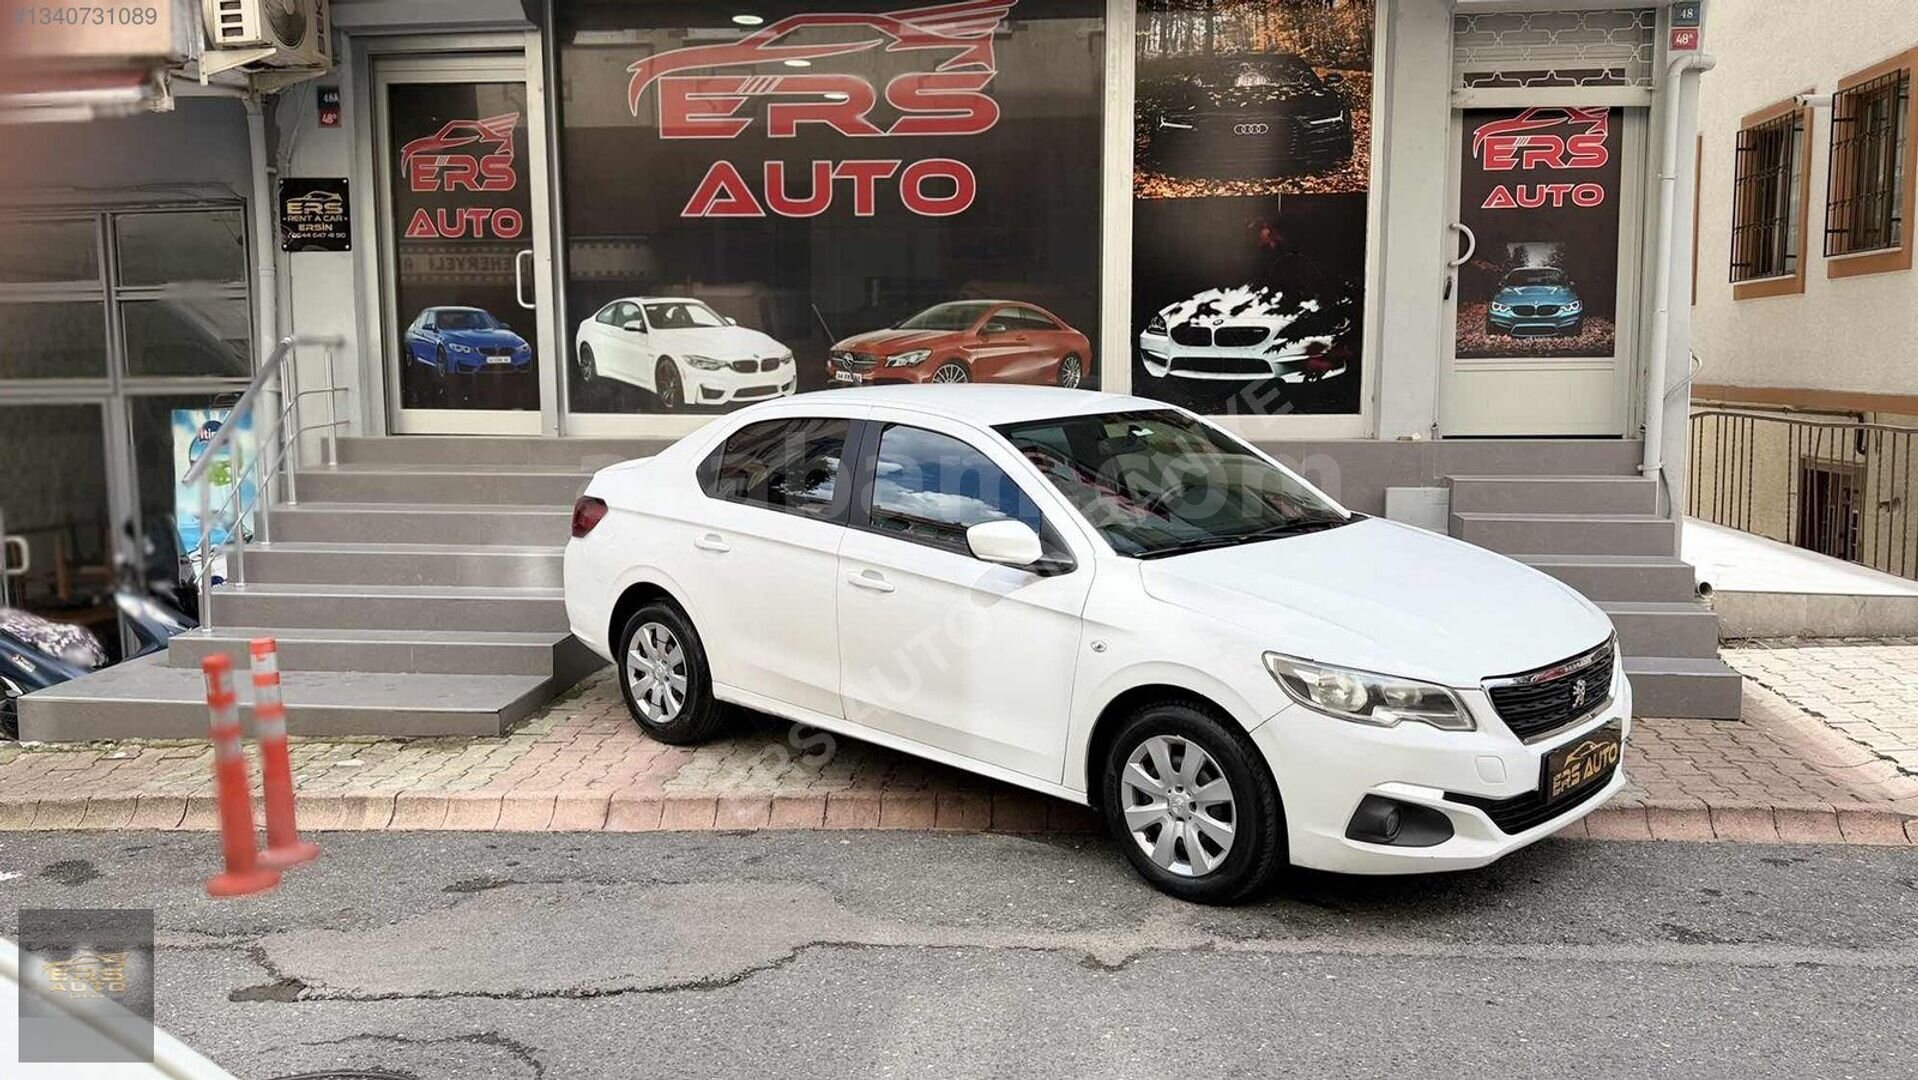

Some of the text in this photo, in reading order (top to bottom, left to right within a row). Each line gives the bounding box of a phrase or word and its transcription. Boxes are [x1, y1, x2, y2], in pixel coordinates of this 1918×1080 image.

[1681, 8, 1694, 18] 48
[659, 71, 1000, 138] ERS
[1483, 134, 1609, 170] ERS
[410, 154, 516, 191] ERS
[680, 158, 976, 217] AUTO
[286, 202, 343, 215] ERS
[1481, 183, 1605, 208] AUTO
[404, 208, 523, 238] AUTO
[1552, 742, 1618, 797] ERS AUTO
